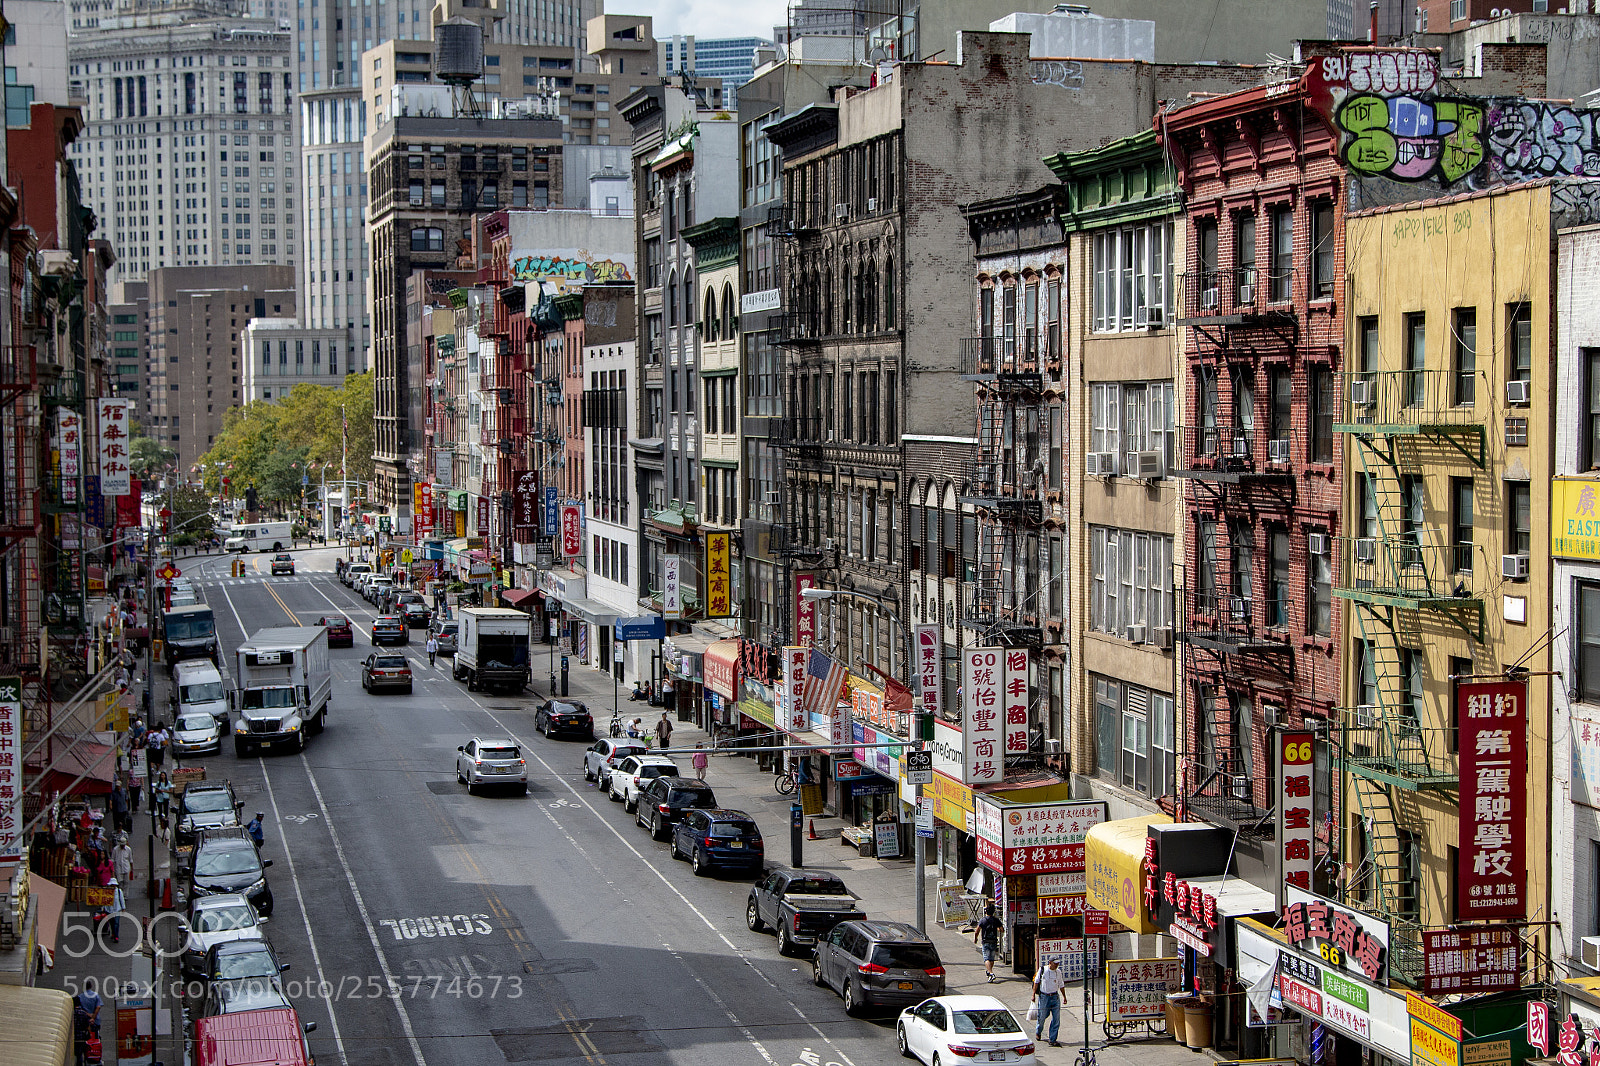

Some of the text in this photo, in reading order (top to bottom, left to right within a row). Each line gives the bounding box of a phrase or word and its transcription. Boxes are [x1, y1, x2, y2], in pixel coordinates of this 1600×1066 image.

[1576, 485, 1597, 517] 廣
[1567, 519, 1600, 537] EAST
[710, 536, 728, 614] 華美商場
[1467, 694, 1518, 718] 紐約
[1285, 742, 1312, 762] 66
[1473, 729, 1513, 877] 第一駕駛學校
[1013, 821, 1080, 837] 福州大花店
[1123, 881, 1134, 911] 64
[1320, 943, 1339, 965] 66
[1117, 963, 1177, 981] 金盛參茸行
